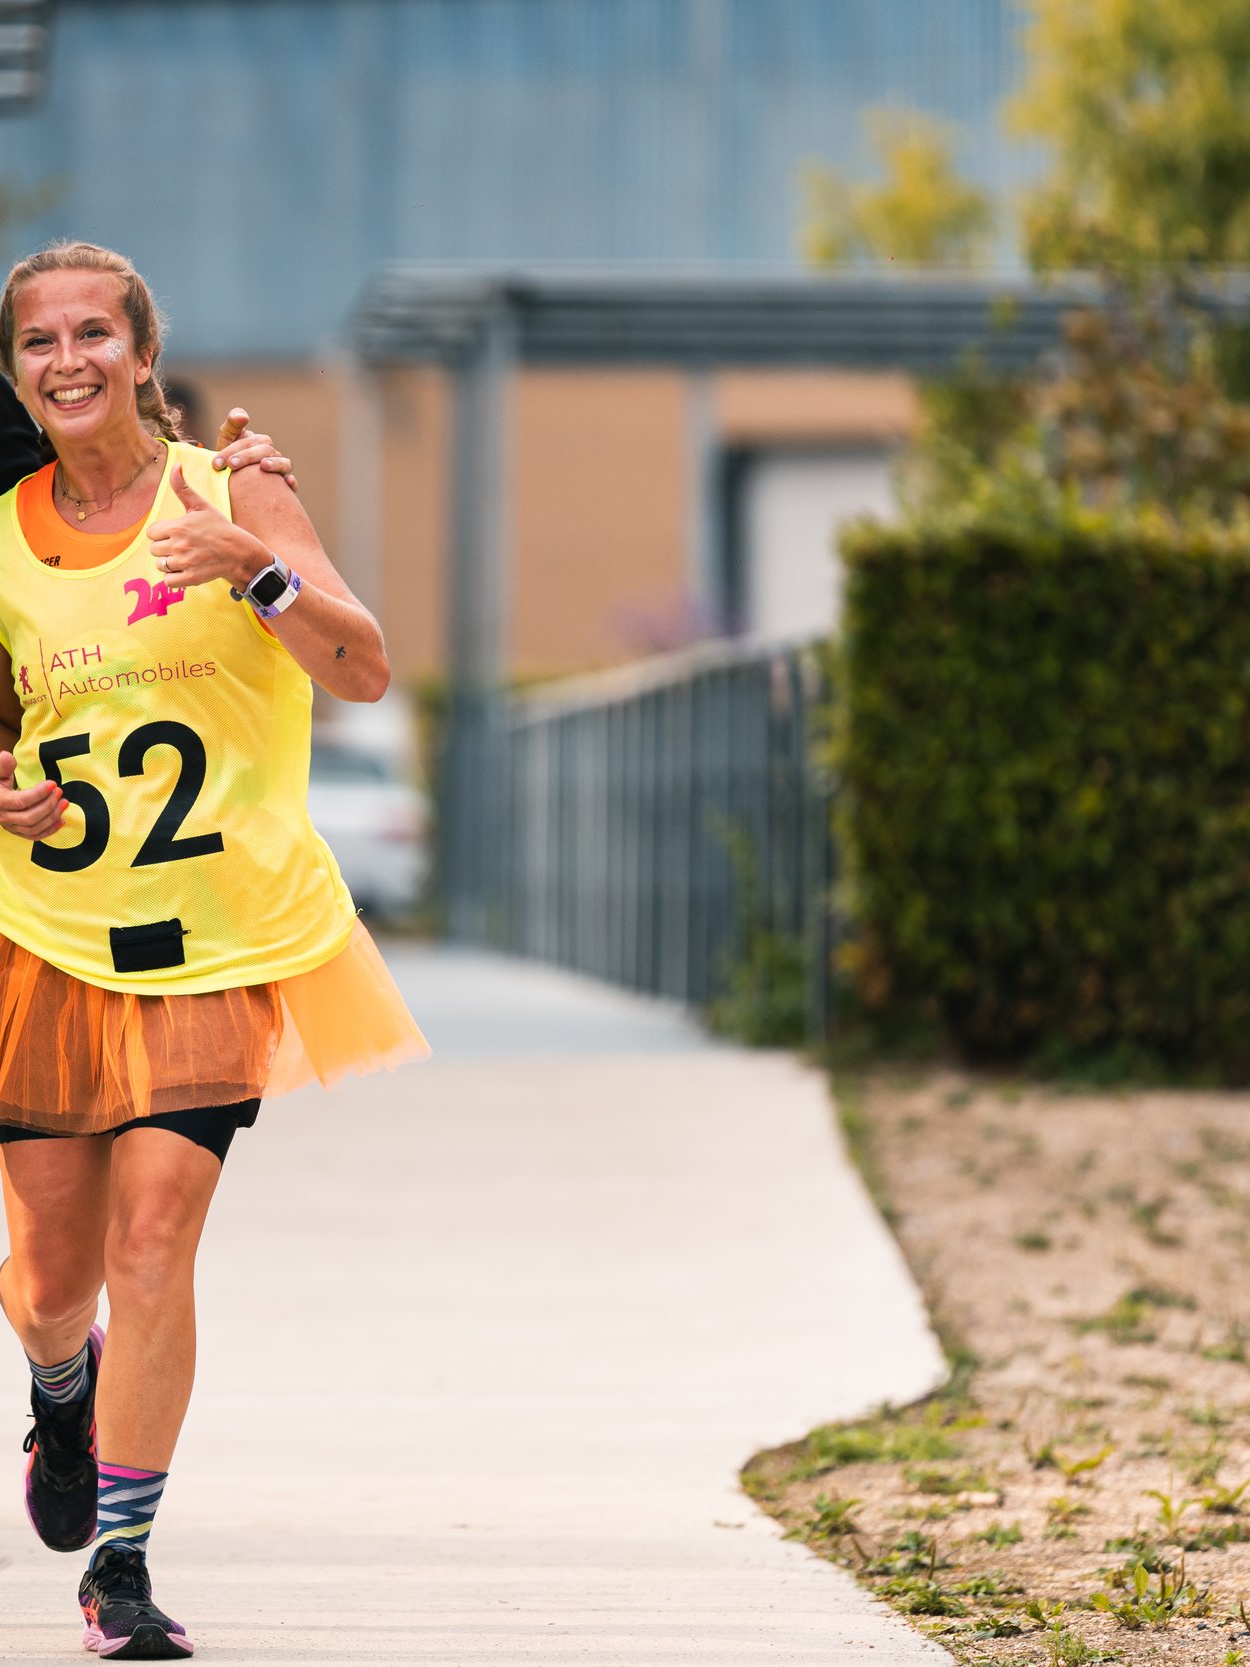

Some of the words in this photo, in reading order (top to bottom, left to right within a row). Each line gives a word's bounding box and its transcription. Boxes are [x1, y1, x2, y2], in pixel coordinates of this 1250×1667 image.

[50, 644, 102, 673] ATH
[59, 659, 217, 700] Automobiles
[30, 720, 225, 873] 52
